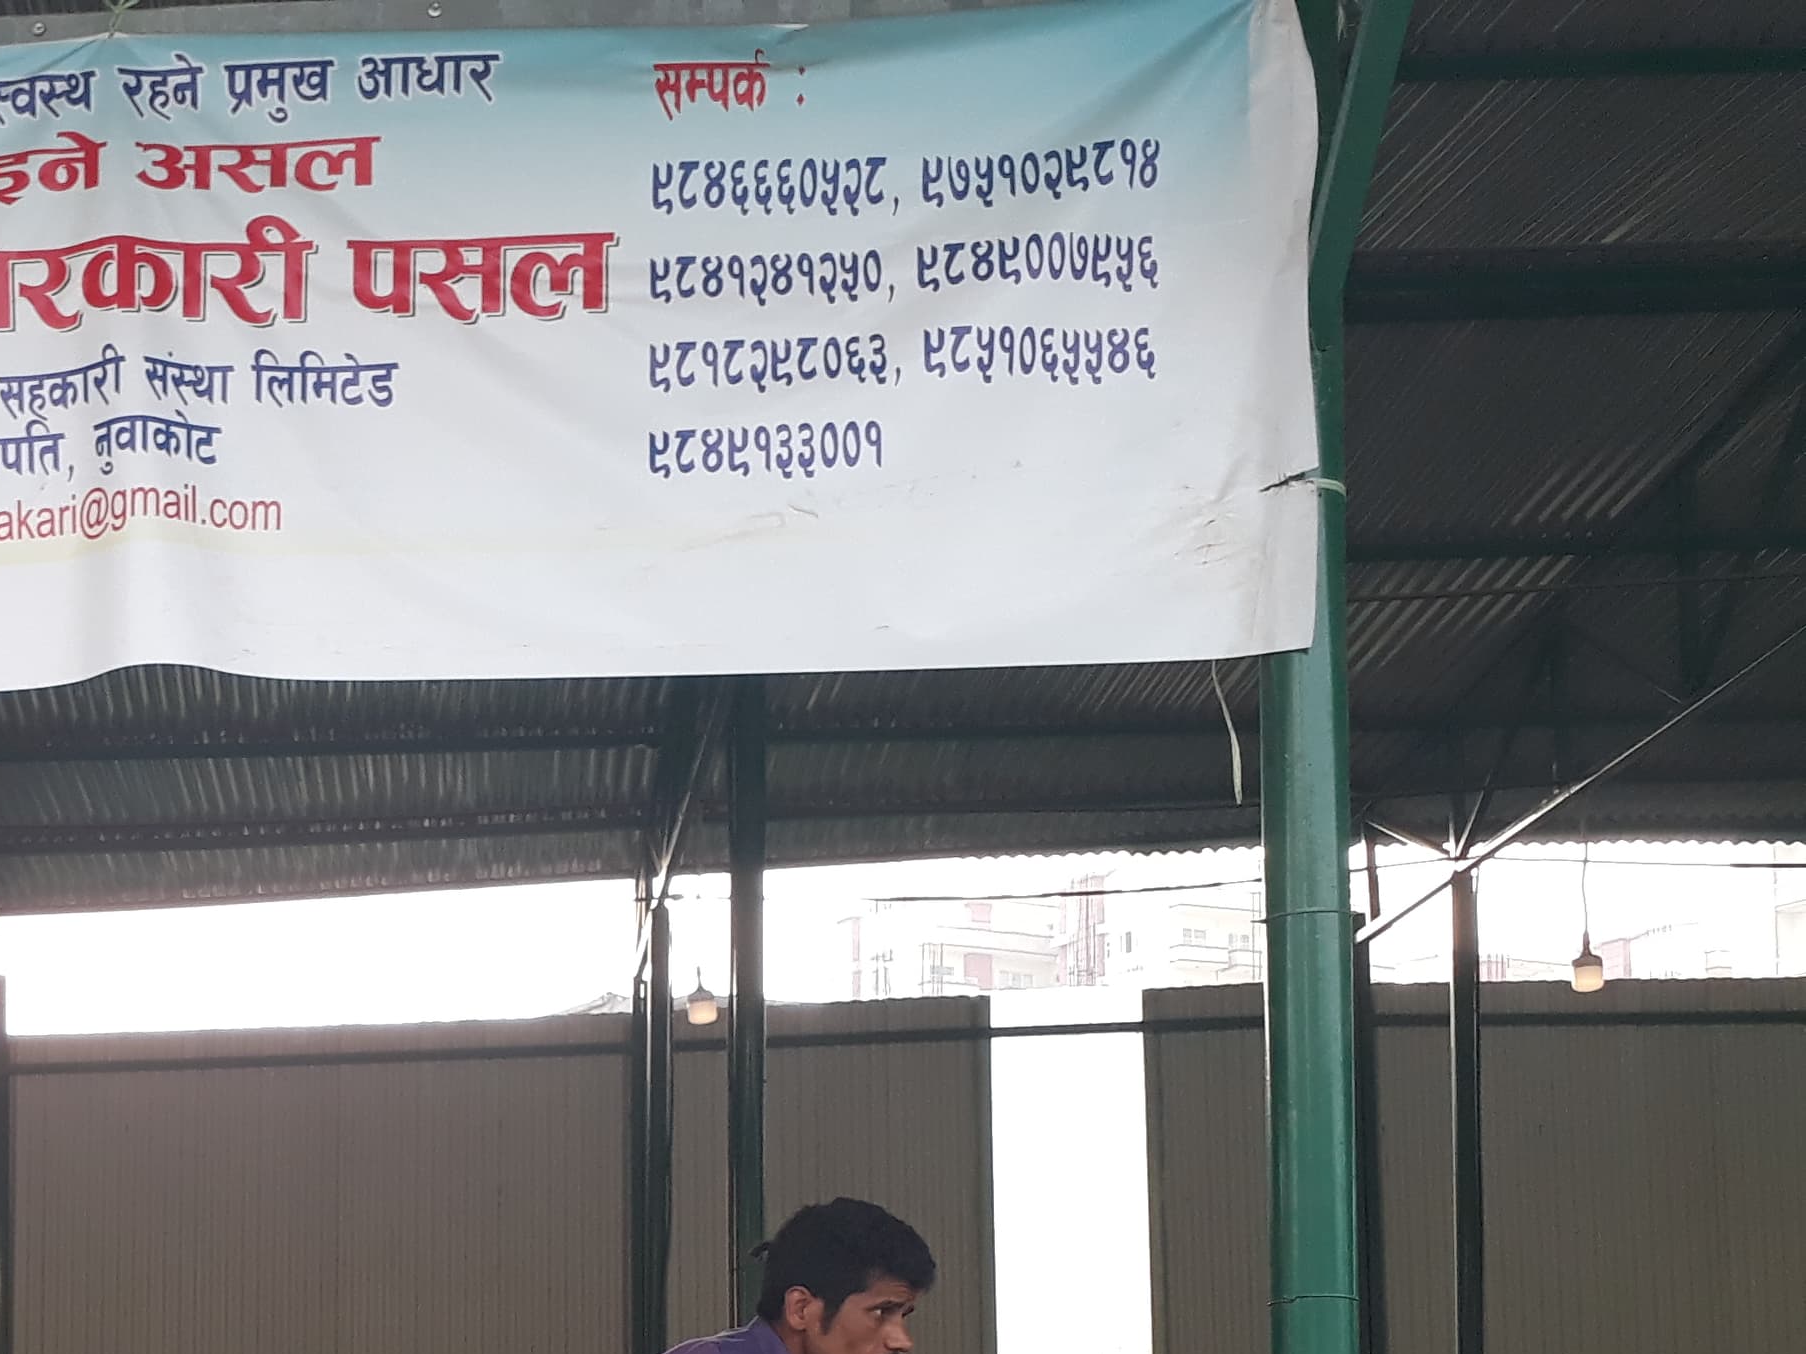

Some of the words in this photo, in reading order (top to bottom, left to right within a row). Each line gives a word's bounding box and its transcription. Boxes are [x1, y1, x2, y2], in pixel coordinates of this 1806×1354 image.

[117, 54, 203, 121] रहने
[224, 58, 333, 122] प्रमुख
[358, 53, 500, 101] आधार
[653, 48, 770, 120] सम्पर्क
[136, 136, 382, 194] असल
[347, 232, 618, 324] पसल
[143, 351, 234, 407] संस्था
[251, 348, 399, 407] लिमिटेड
[94, 410, 222, 475] नुवाकोट
